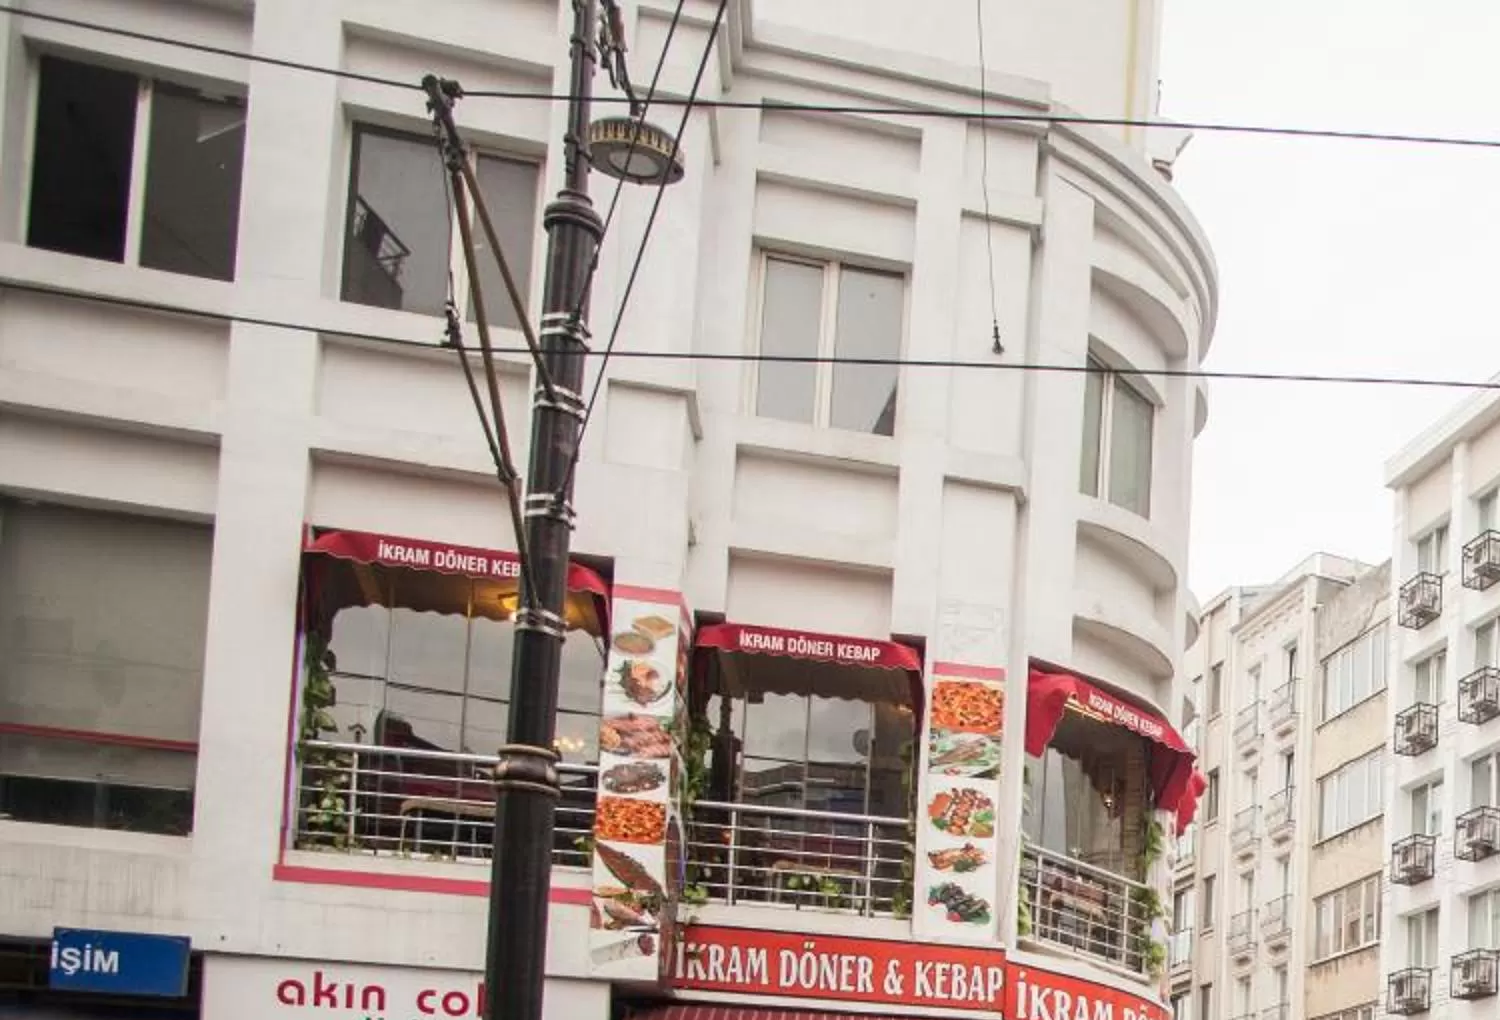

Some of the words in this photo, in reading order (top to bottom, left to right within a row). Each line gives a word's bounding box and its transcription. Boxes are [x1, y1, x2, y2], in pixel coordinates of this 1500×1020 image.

[378, 540, 430, 565] İKRAM
[434, 550, 488, 573] DÖNER
[492, 559, 521, 577] KEB
[739, 629, 784, 651] İKRAM
[787, 635, 834, 656] DÖNER
[837, 643, 881, 661] KEBAP
[51, 940, 120, 976] İŞİM
[778, 941, 875, 994] DÖNER
[883, 959, 905, 996] &
[913, 960, 1005, 1003] KEBAP
[416, 982, 485, 1018] col
